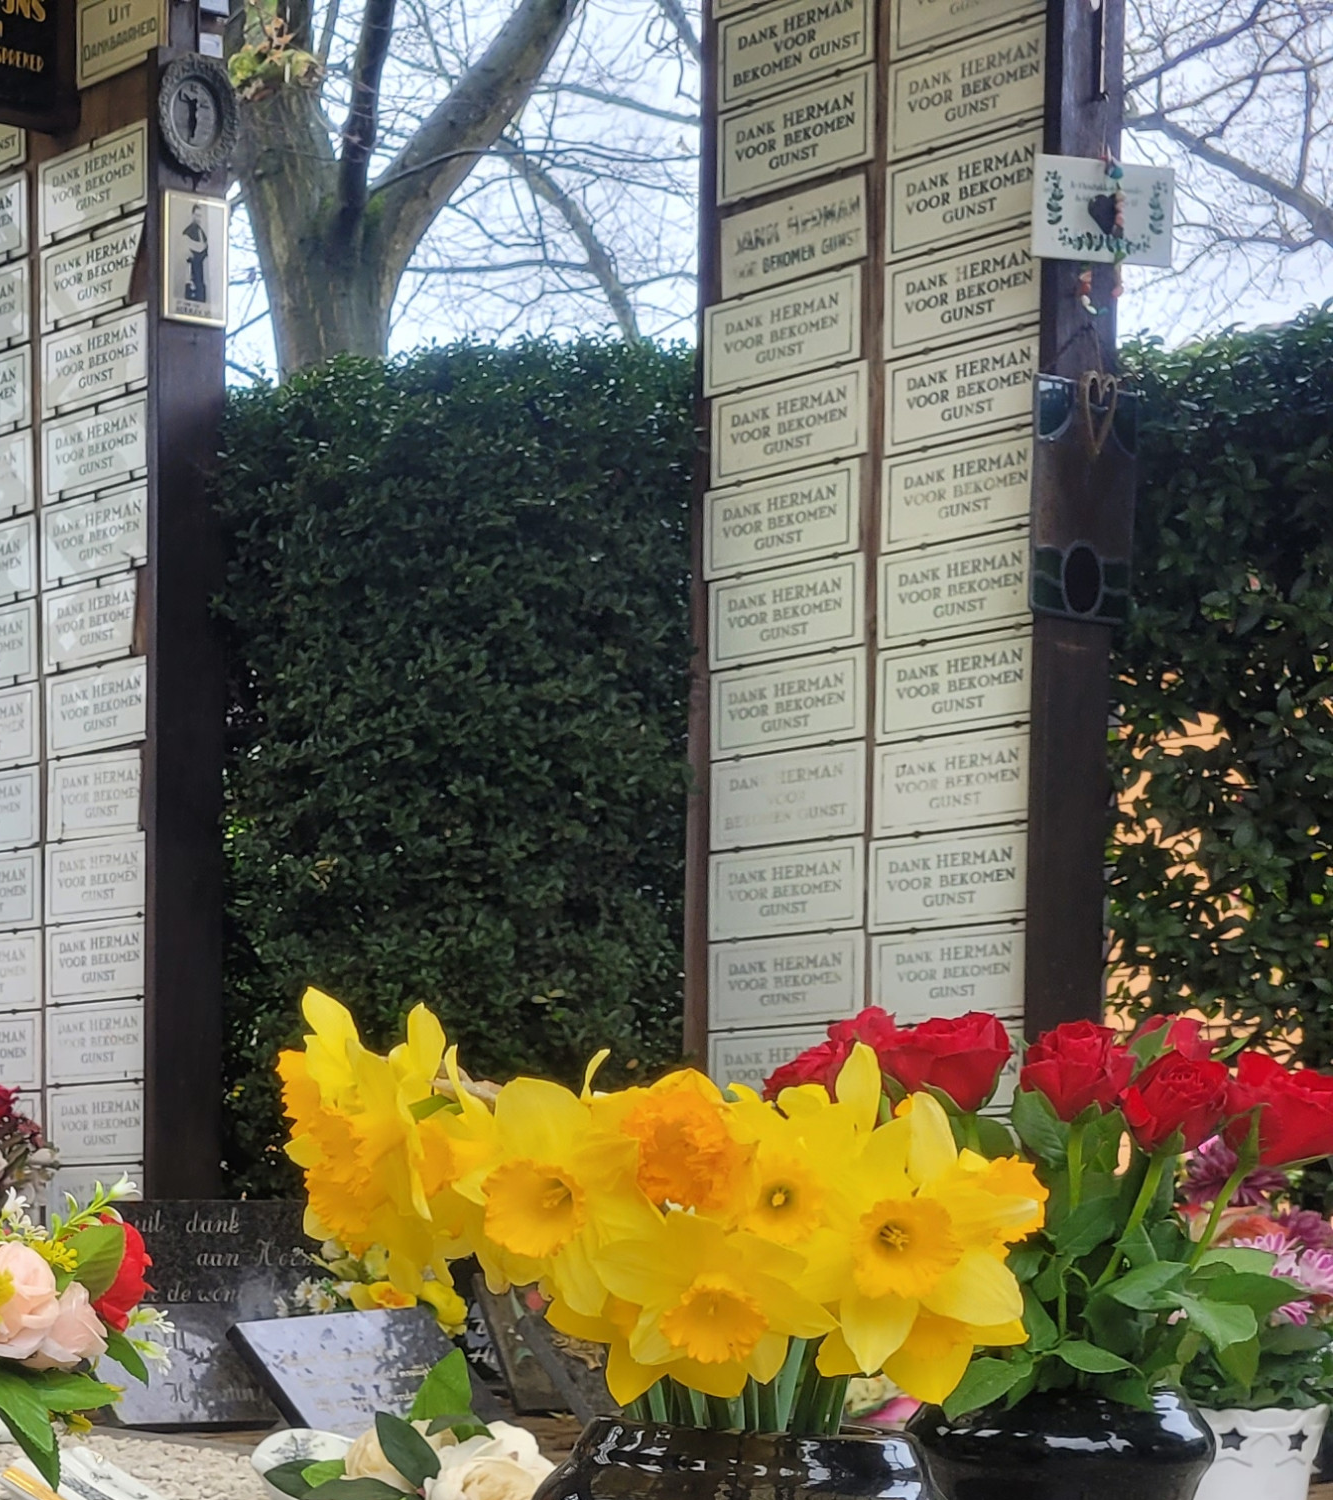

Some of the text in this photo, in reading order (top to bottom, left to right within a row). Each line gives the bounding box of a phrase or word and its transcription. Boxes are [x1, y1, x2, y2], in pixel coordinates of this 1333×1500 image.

[108, 3, 132, 25] UIT
[908, 38, 1040, 96] DANK HERMAN
[908, 60, 1041, 113] VOOR BEKOMEN
[736, 92, 855, 145] DANK HERMAN
[944, 94, 1000, 122] GUNST
[735, 112, 856, 161] VOOR BEKOMEN
[52, 142, 136, 188] DANK HERMAN
[769, 143, 819, 170] GUNST
[52, 162, 136, 204] VOOR BEKOMEN
[76, 189, 112, 212] GUNST
[55, 323, 138, 363] DANK HERMAN
[56, 342, 139, 378] VOOR BEKOMEN
[79, 368, 114, 389] GUNST
[897, 648, 1024, 682] DANK HERMAN
[896, 668, 1024, 700] VOOR BEKOMEN
[932, 695, 985, 714] GUNST
[59, 932, 139, 954] DANK HERMAN
[59, 950, 140, 968] VOOR BEKOMEN
[82, 969, 115, 983] GUNST
[186, 1209, 240, 1235] dank
[196, 1253, 240, 1268] aan
